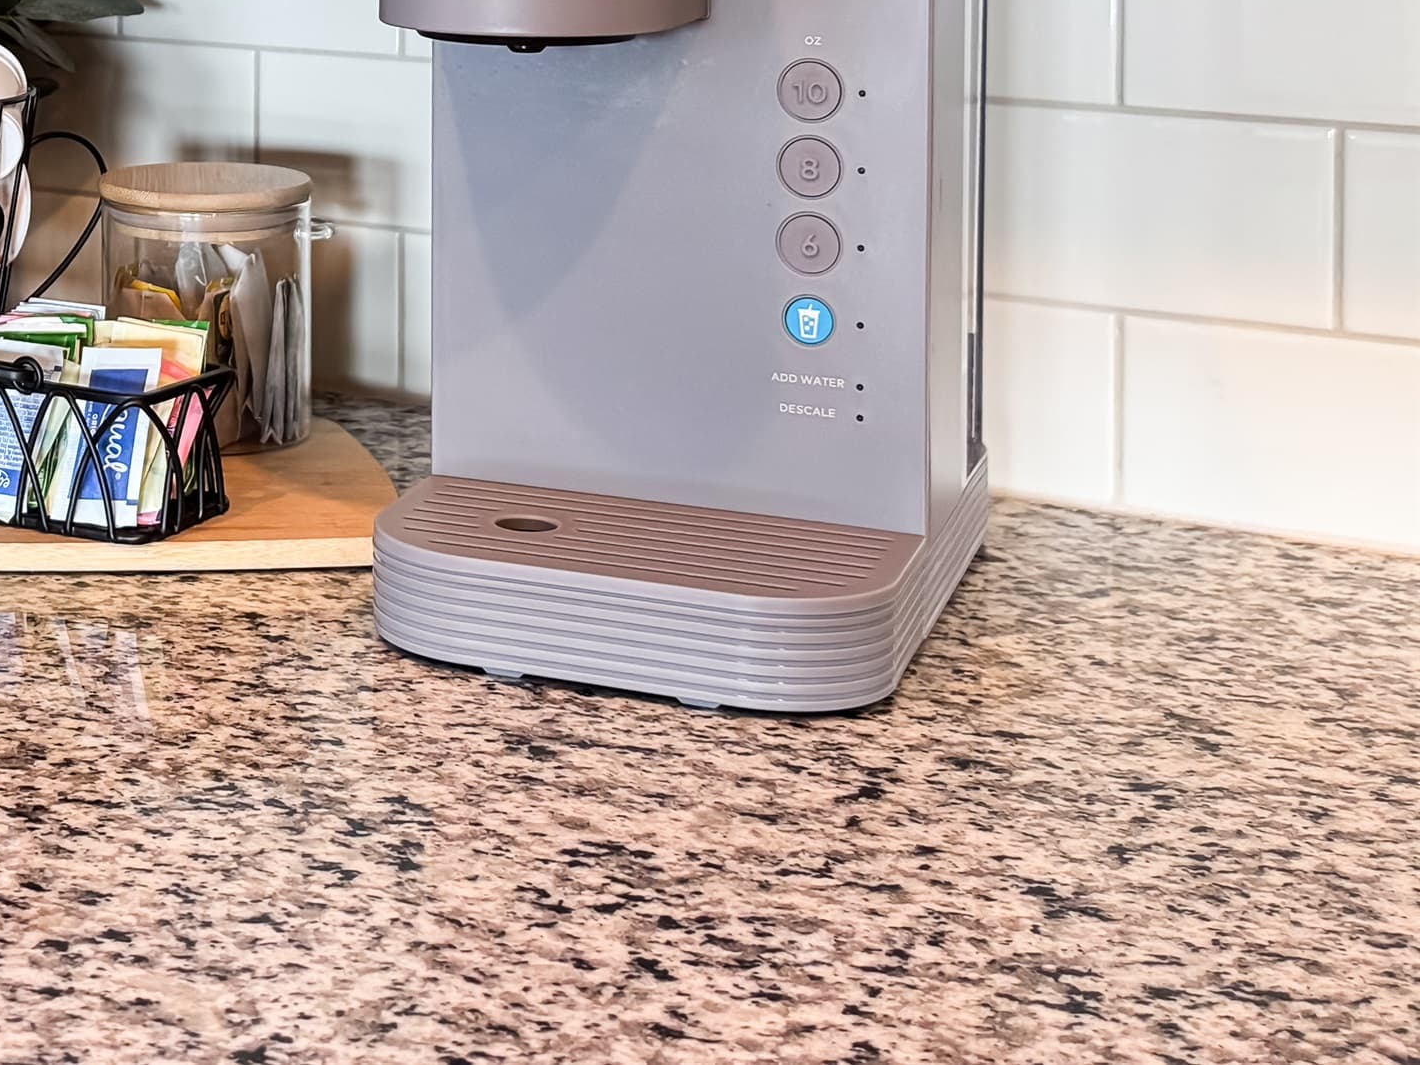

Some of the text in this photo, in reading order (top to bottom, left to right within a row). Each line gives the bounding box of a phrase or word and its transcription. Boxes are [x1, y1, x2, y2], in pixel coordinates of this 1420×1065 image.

[791, 81, 829, 105] 10
[800, 158, 820, 182] 8
[800, 233, 820, 259] 6
[771, 372, 845, 389] ADD WATER
[779, 402, 837, 418] DESCALE
